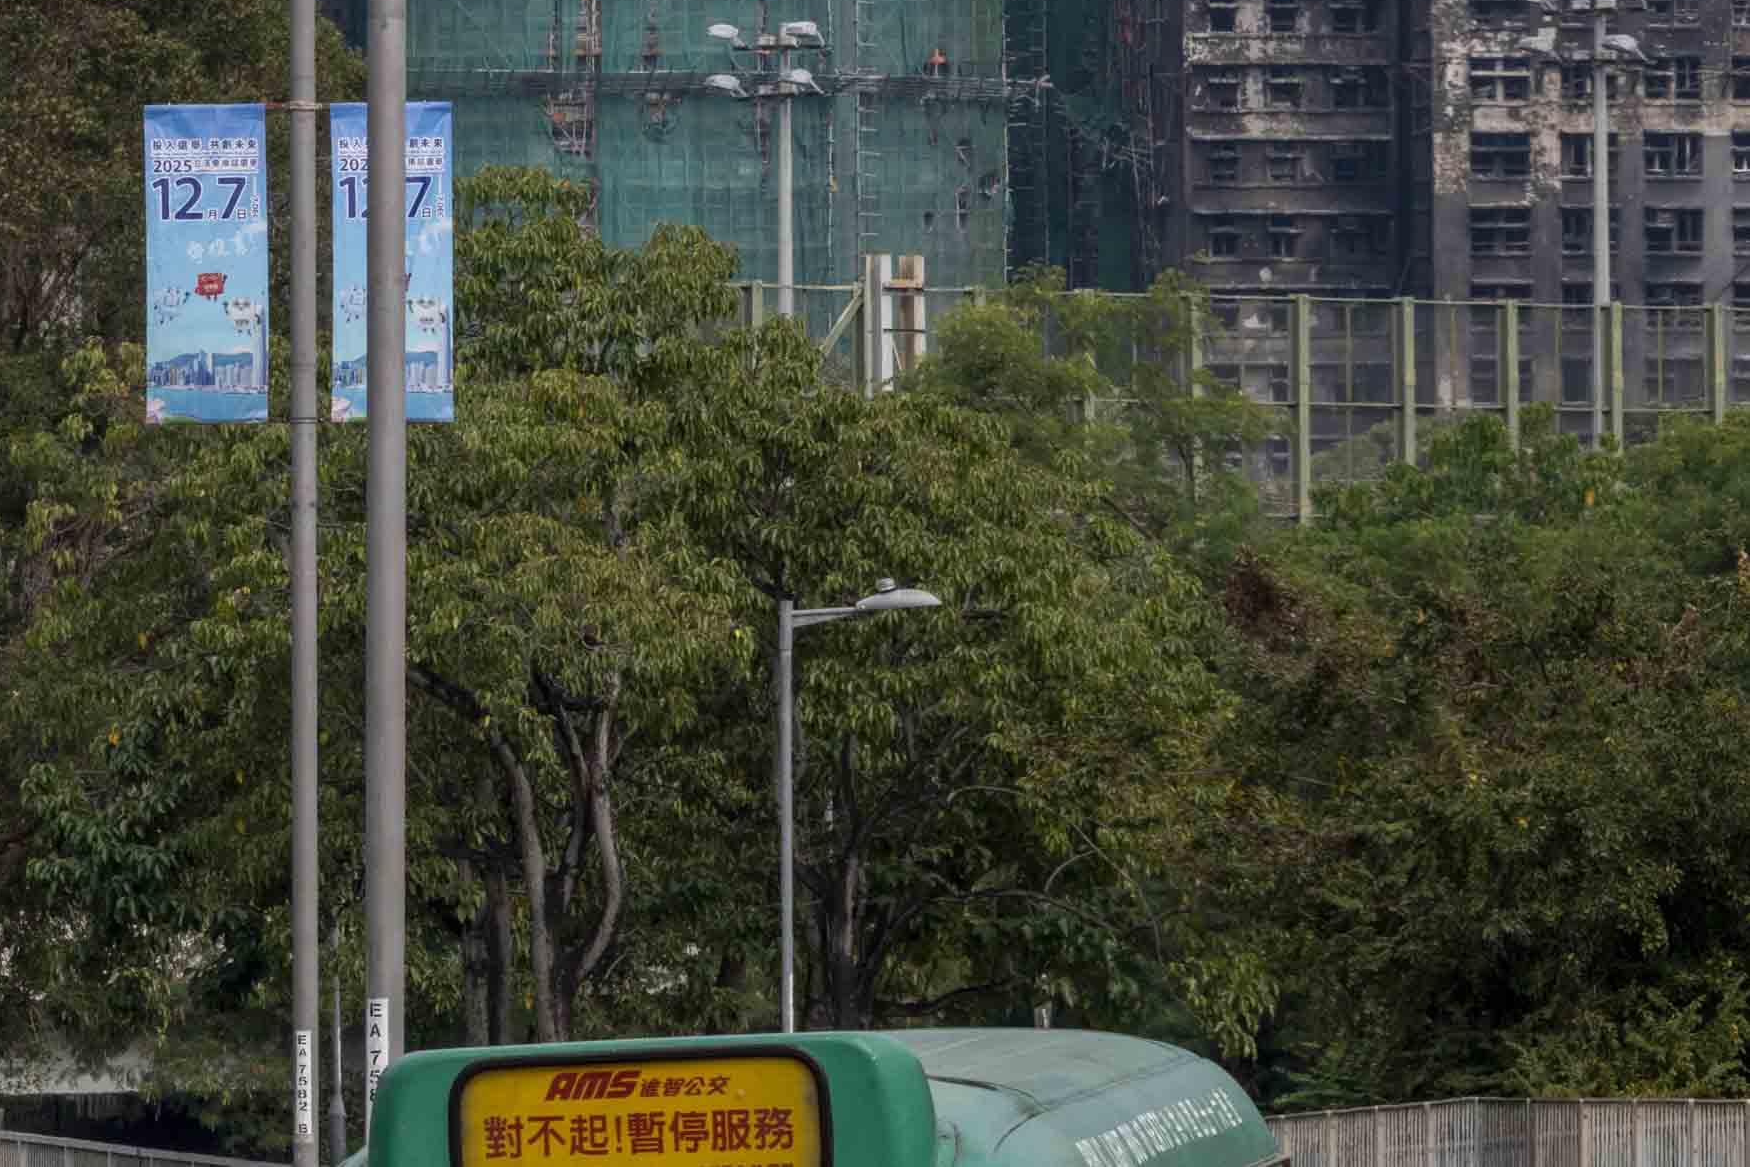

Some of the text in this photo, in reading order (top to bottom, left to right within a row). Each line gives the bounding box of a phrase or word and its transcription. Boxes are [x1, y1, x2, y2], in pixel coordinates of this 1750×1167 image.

[153, 160, 192, 173] 2025
[340, 158, 369, 172] 202
[297, 1034, 307, 1057] EA
[545, 1070, 641, 1102] AMS
[483, 1106, 795, 1160] 對不起!暫停服務
